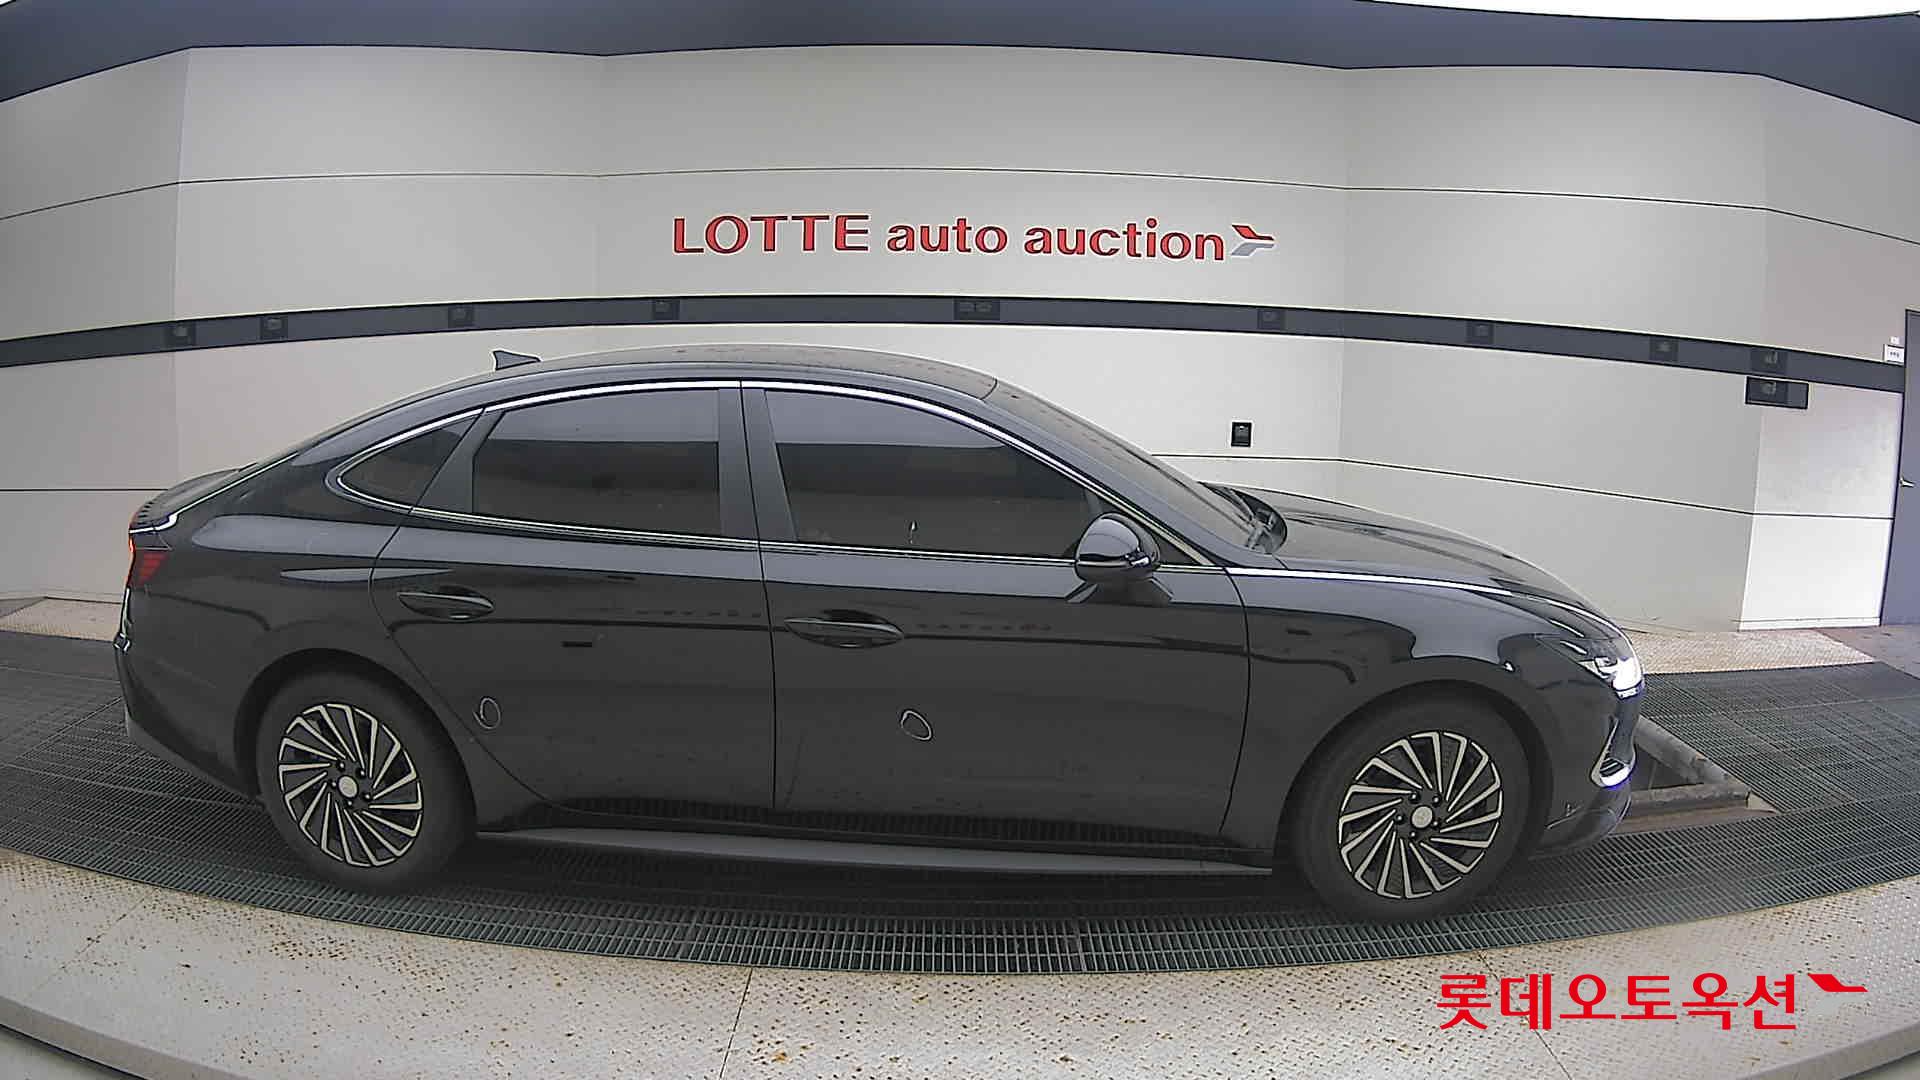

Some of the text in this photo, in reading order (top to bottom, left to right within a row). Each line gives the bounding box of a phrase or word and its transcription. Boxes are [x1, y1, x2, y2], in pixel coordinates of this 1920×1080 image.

[673, 215, 1225, 261] LOTTE auto auction
